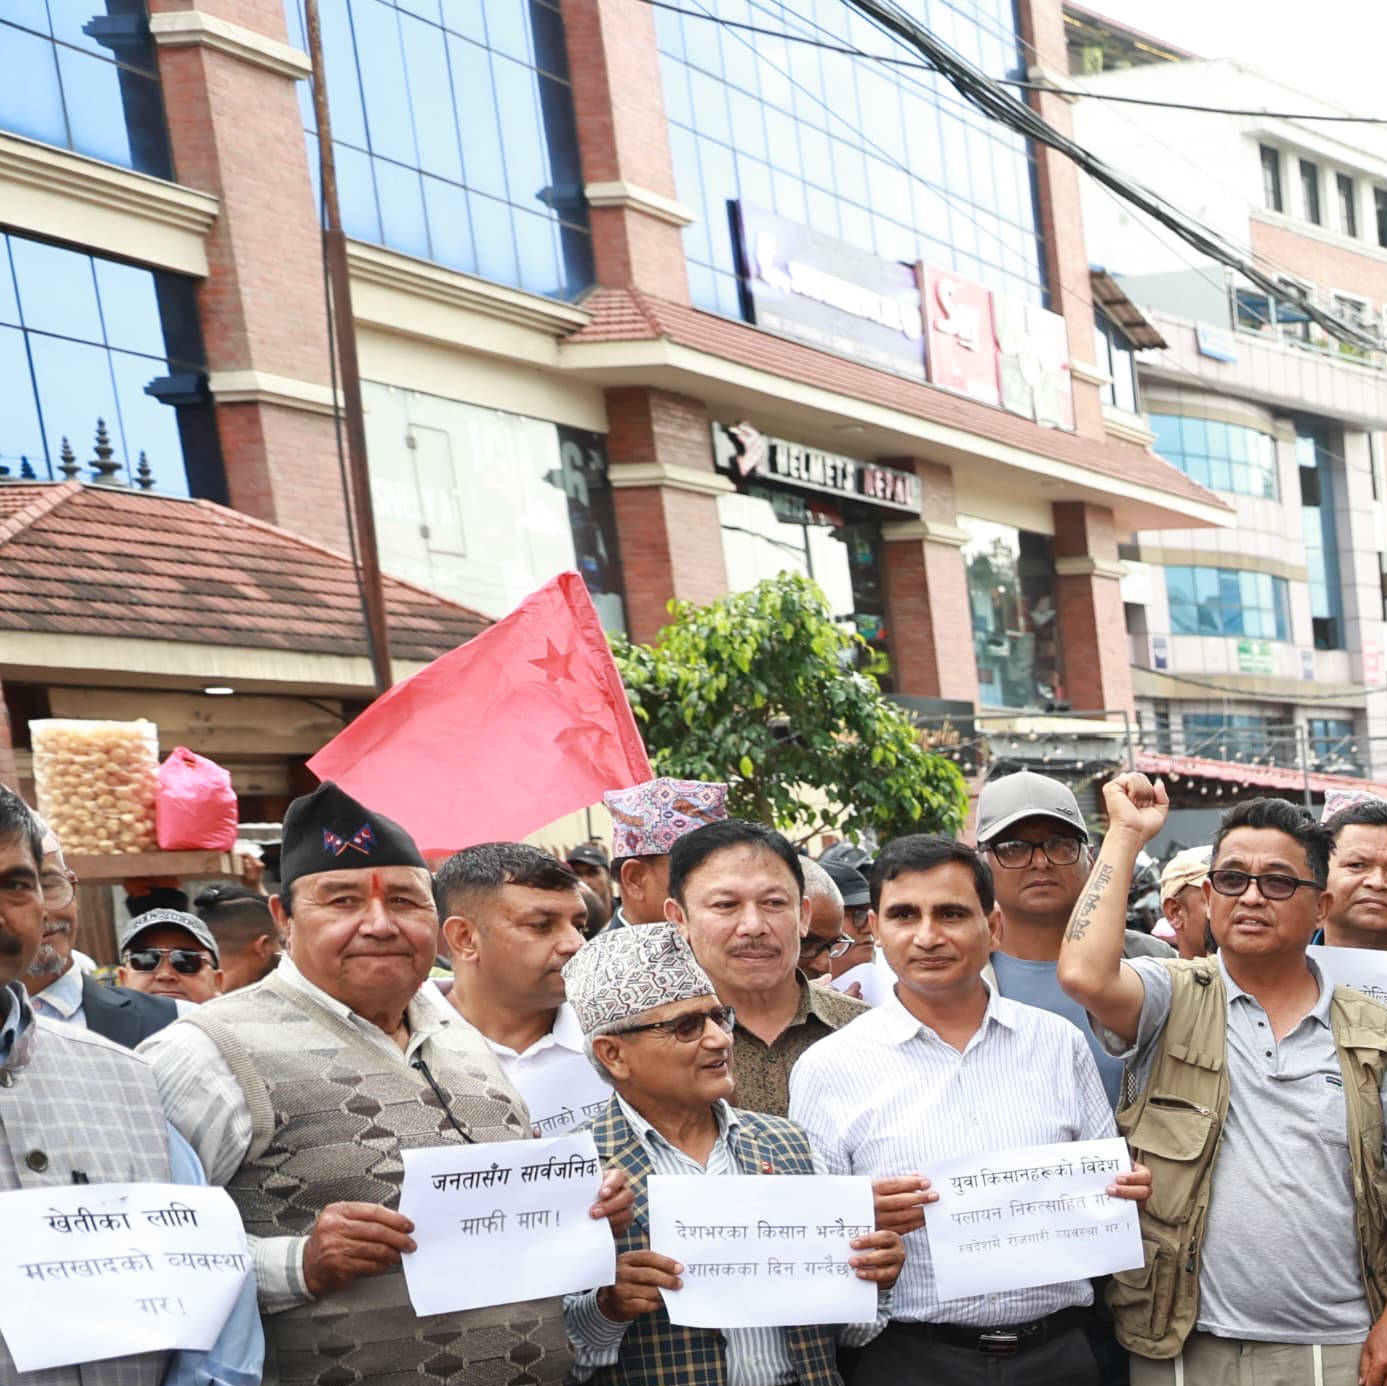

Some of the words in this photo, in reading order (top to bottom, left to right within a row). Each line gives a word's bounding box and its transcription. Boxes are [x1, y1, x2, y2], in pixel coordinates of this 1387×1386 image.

[775, 443, 856, 491] HELMETS
[863, 463, 913, 507] NEPAL
[431, 1161, 513, 1193] जनतासँग
[520, 1153, 599, 1184] सार्वजनिक
[1080, 1155, 1121, 1175] विदेश
[42, 1206, 132, 1234] खेतीका
[140, 1201, 199, 1228] लागि
[460, 1207, 508, 1237] माफी
[674, 1219, 749, 1241] देशभरका
[757, 1220, 808, 1240] किसान
[950, 1206, 1003, 1227] पलायन
[18, 1247, 155, 1282] मलखादको
[163, 1251, 248, 1274] व्यवस्था
[687, 1262, 761, 1278] शासकका
[768, 1256, 795, 1277] दिन
[803, 1254, 858, 1278] गन्दैछ
